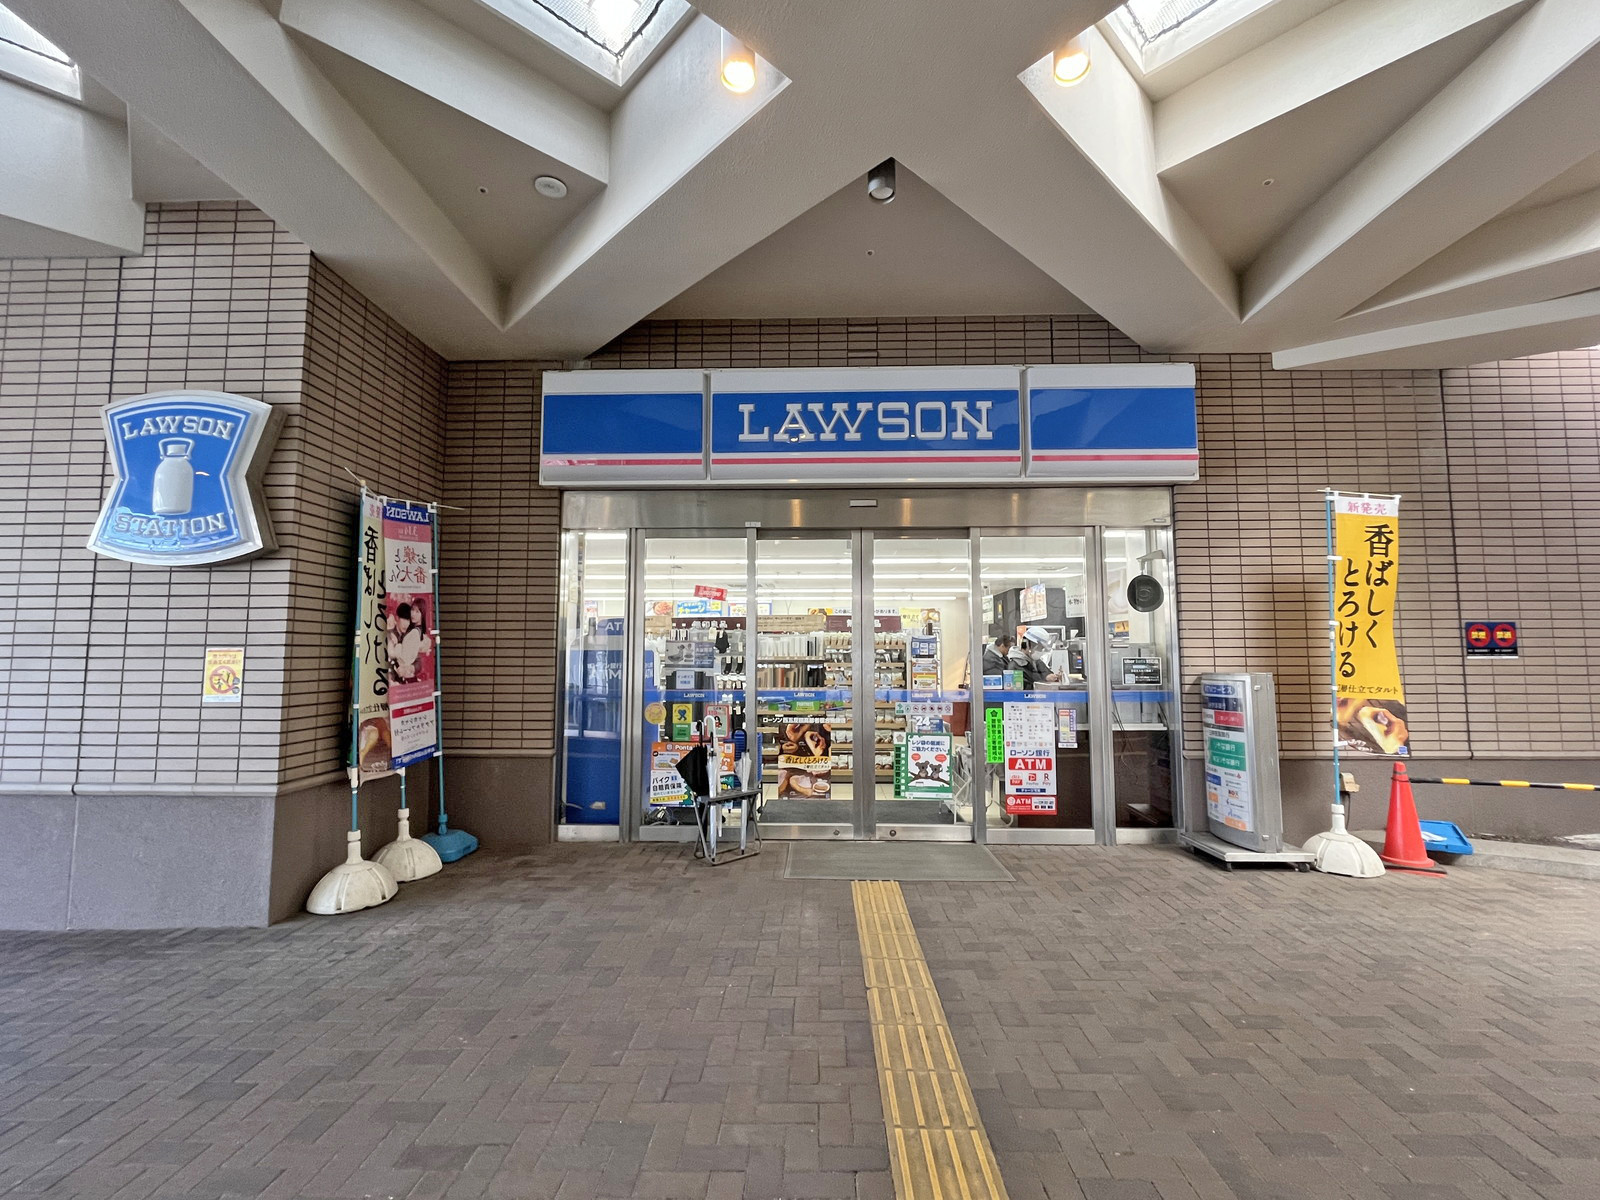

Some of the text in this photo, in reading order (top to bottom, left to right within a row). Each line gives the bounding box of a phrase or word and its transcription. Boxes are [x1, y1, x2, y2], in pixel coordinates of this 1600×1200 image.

[122, 415, 234, 441] LAWSON
[738, 400, 993, 442] LAWSON
[1347, 501, 1387, 515] 新発売
[115, 513, 227, 538] STATION
[1364, 523, 1395, 649] 香ばしく
[605, 622, 624, 631] AT
[1338, 558, 1360, 678] とろける
[1015, 758, 1047, 770] ATM
[652, 776, 670, 785] バイク
